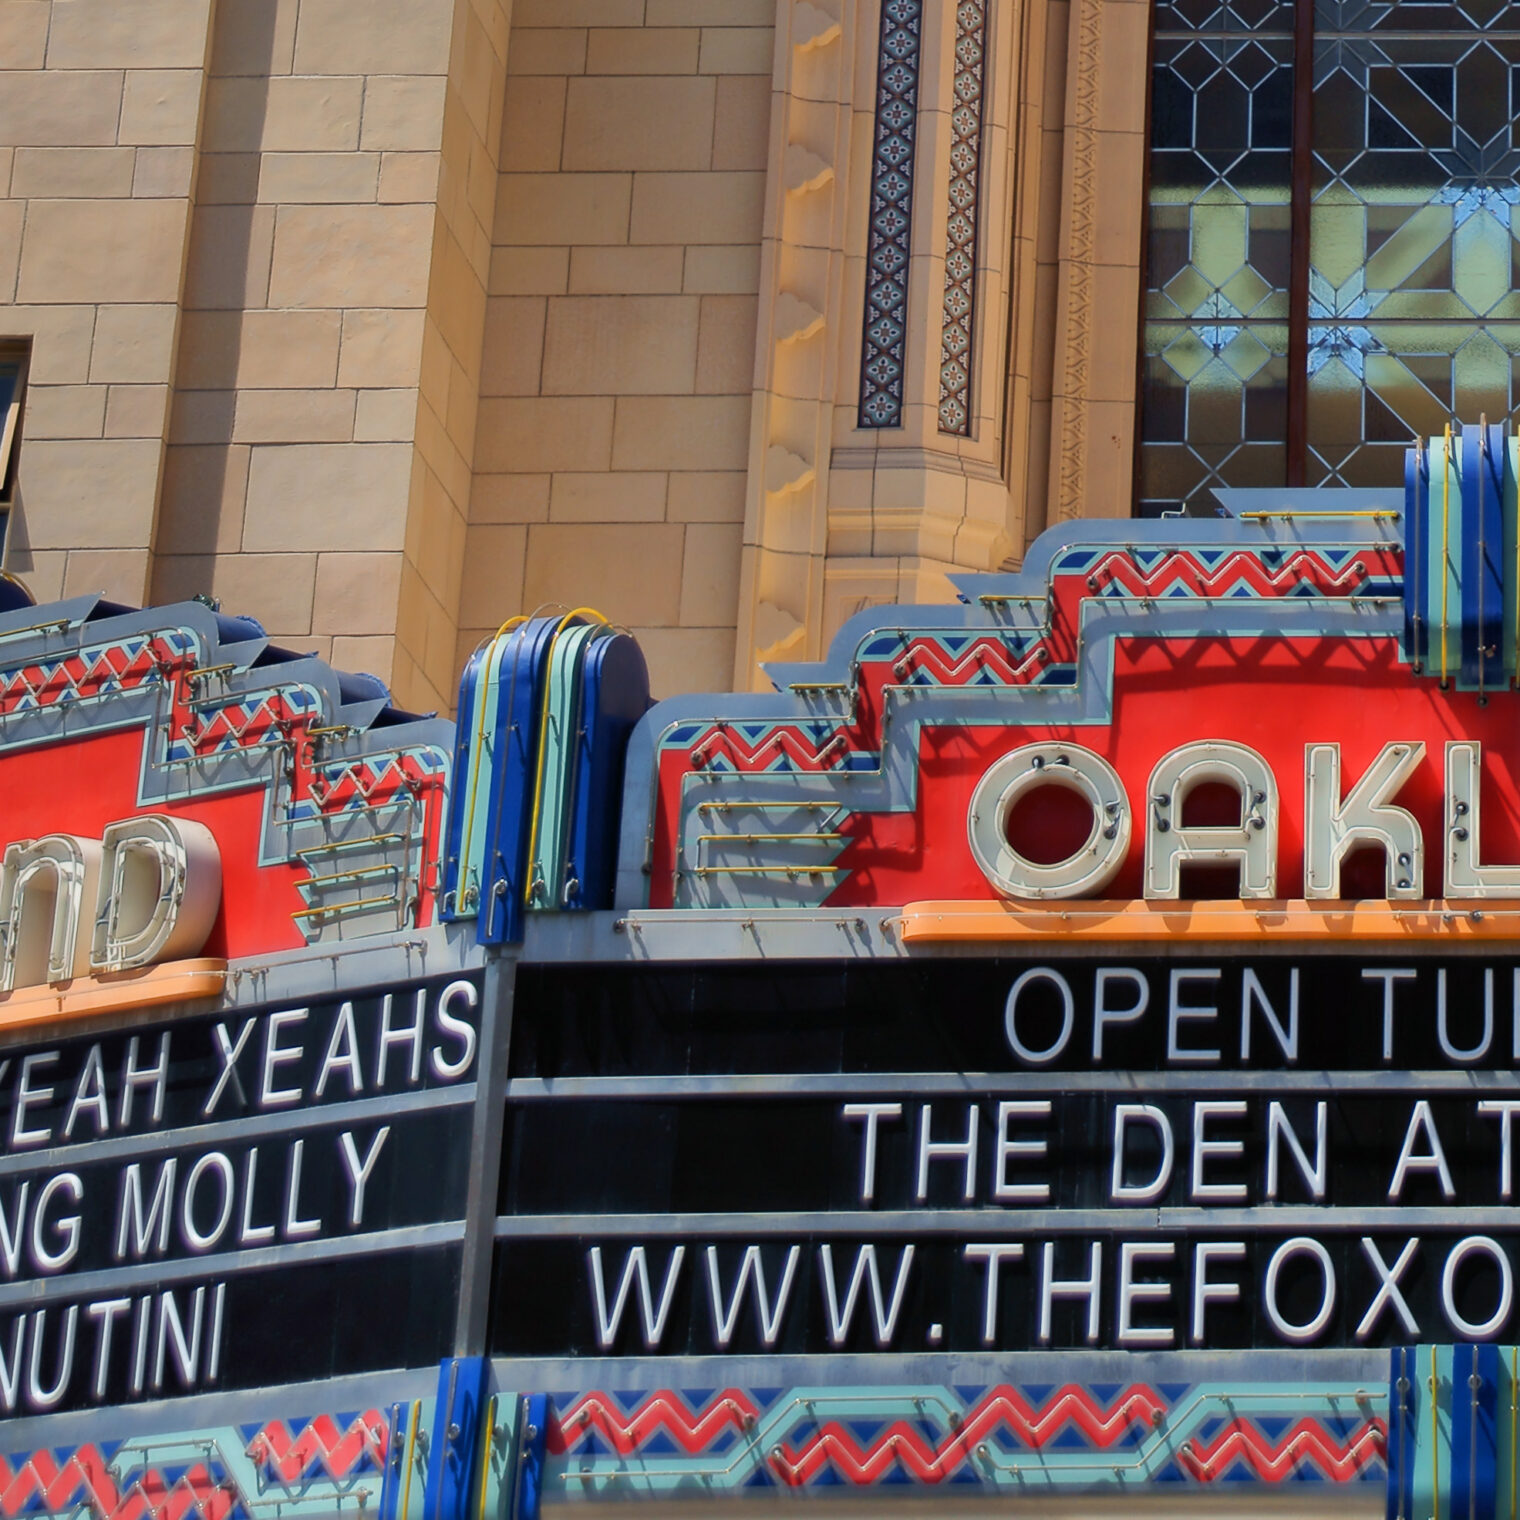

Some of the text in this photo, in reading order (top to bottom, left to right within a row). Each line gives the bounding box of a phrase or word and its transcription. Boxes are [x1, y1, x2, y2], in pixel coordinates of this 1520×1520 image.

[1004, 966, 1300, 1063] OPEN
[0, 1033, 172, 1146] EAH
[116, 1126, 391, 1259] MOLLY
[842, 1099, 1053, 1201] THE
[1110, 1100, 1328, 1200] DEN
